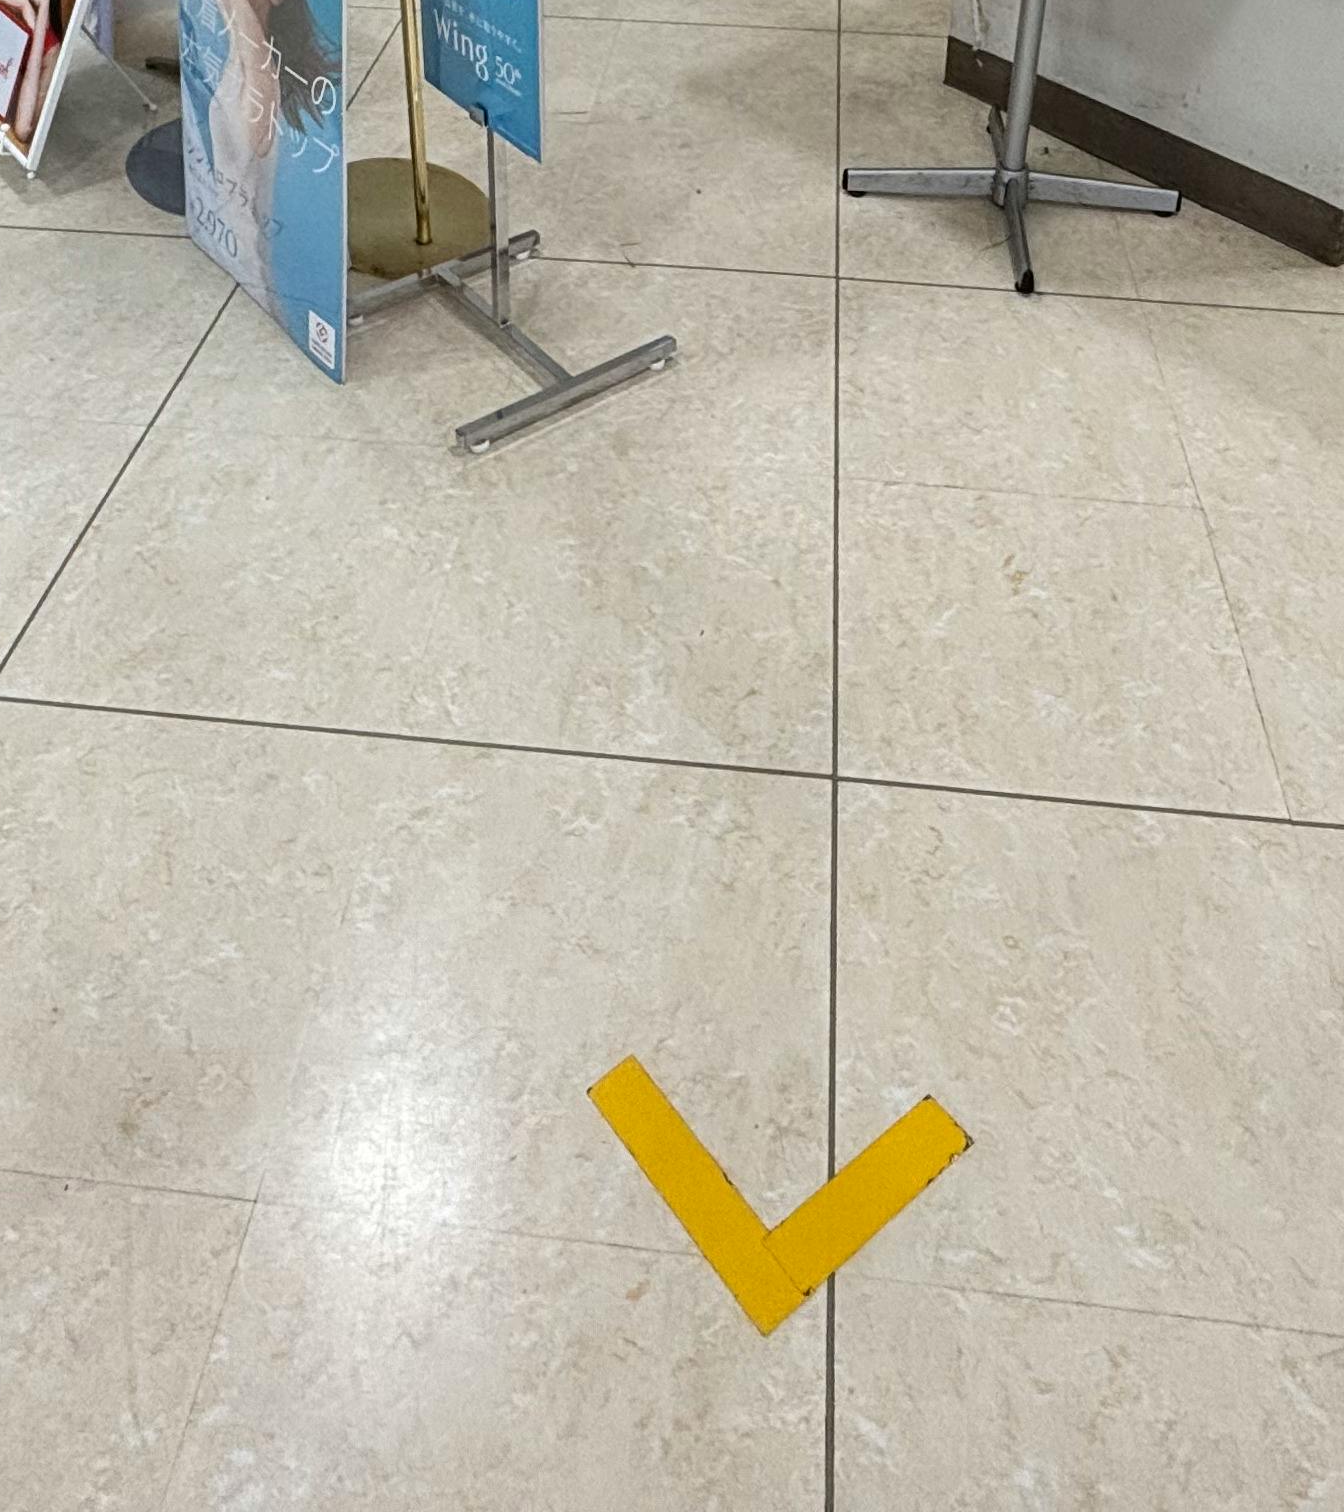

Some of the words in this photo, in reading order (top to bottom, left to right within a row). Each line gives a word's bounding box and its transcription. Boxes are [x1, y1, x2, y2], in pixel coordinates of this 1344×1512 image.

[433, 8, 490, 82] Wing
[181, 31, 340, 173] 本気ラトップ
